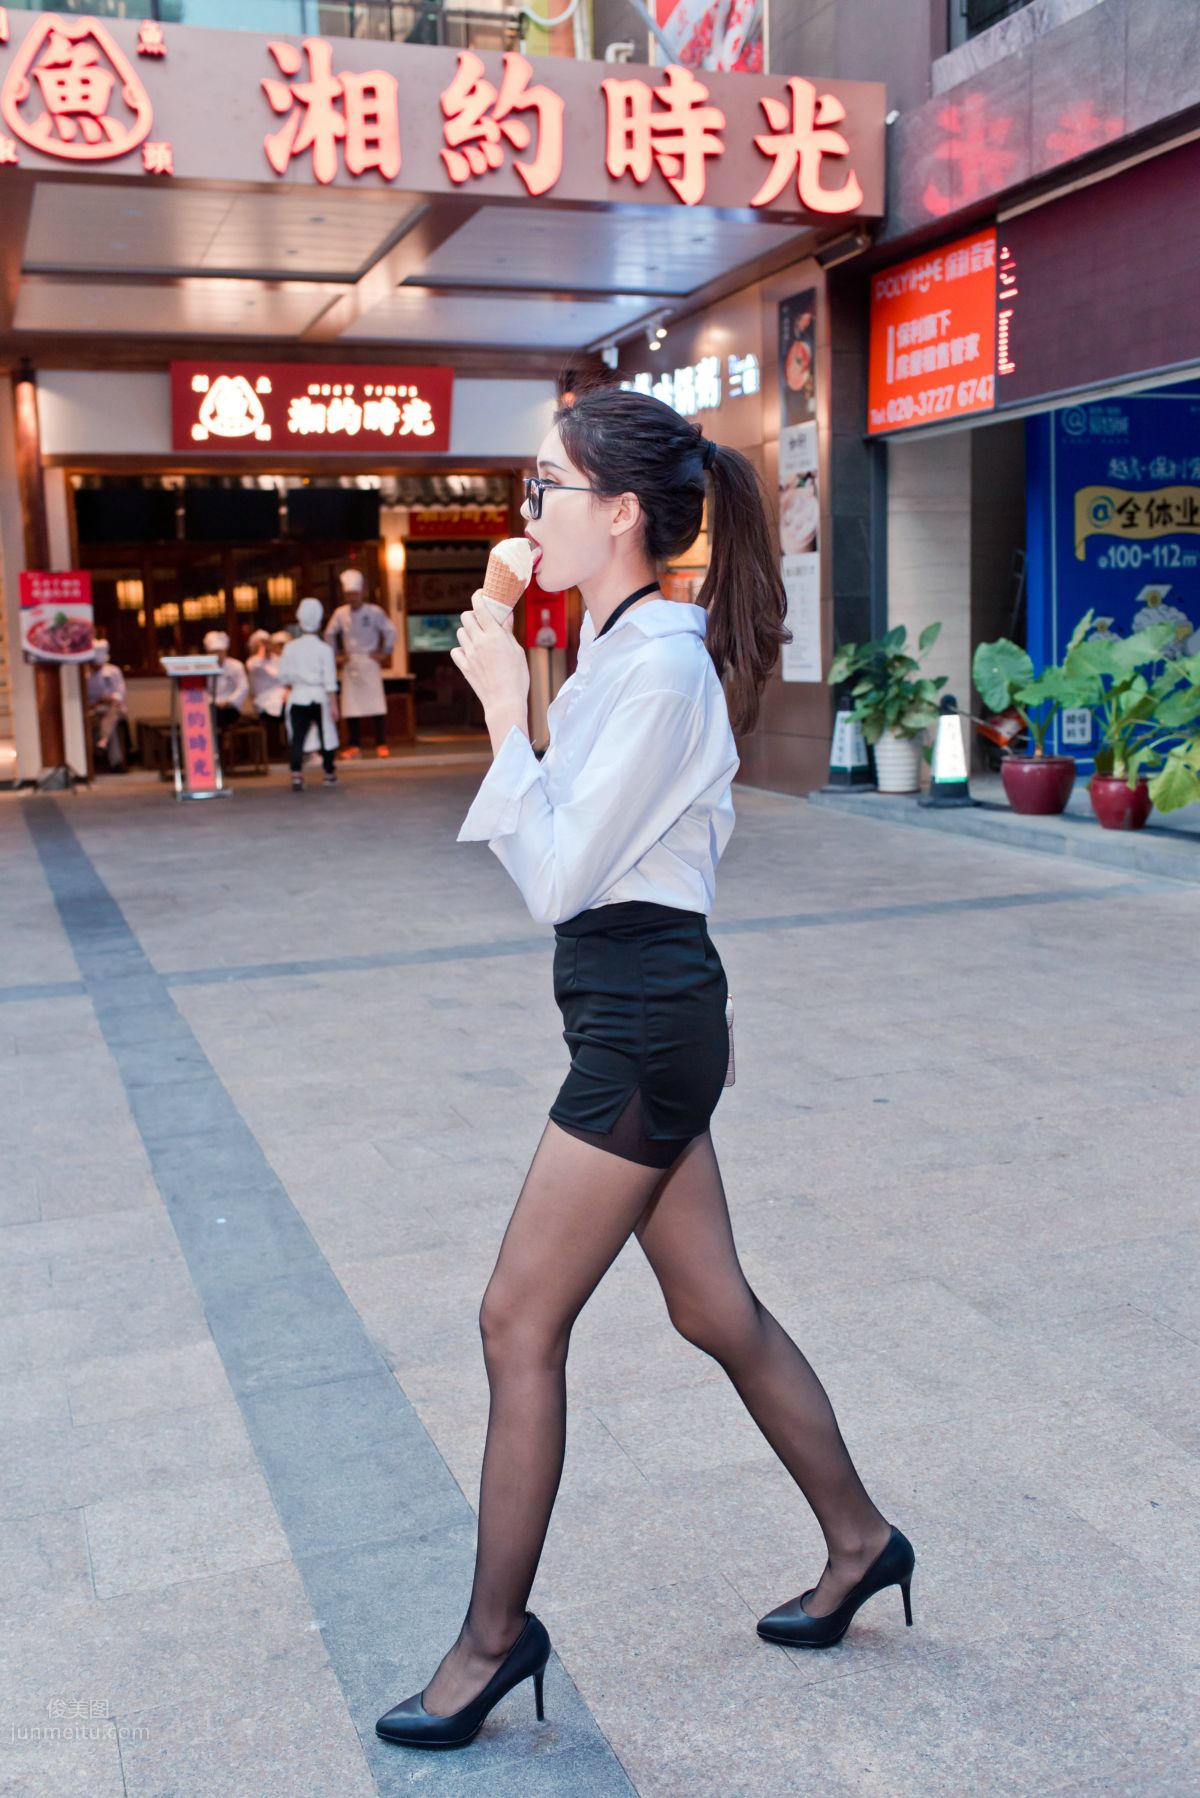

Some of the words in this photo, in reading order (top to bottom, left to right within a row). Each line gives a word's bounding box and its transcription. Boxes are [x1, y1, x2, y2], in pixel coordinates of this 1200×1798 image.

[260, 37, 864, 214] 湘約時光
[887, 384, 955, 422] 020-3727
[957, 375, 995, 407] 6747
